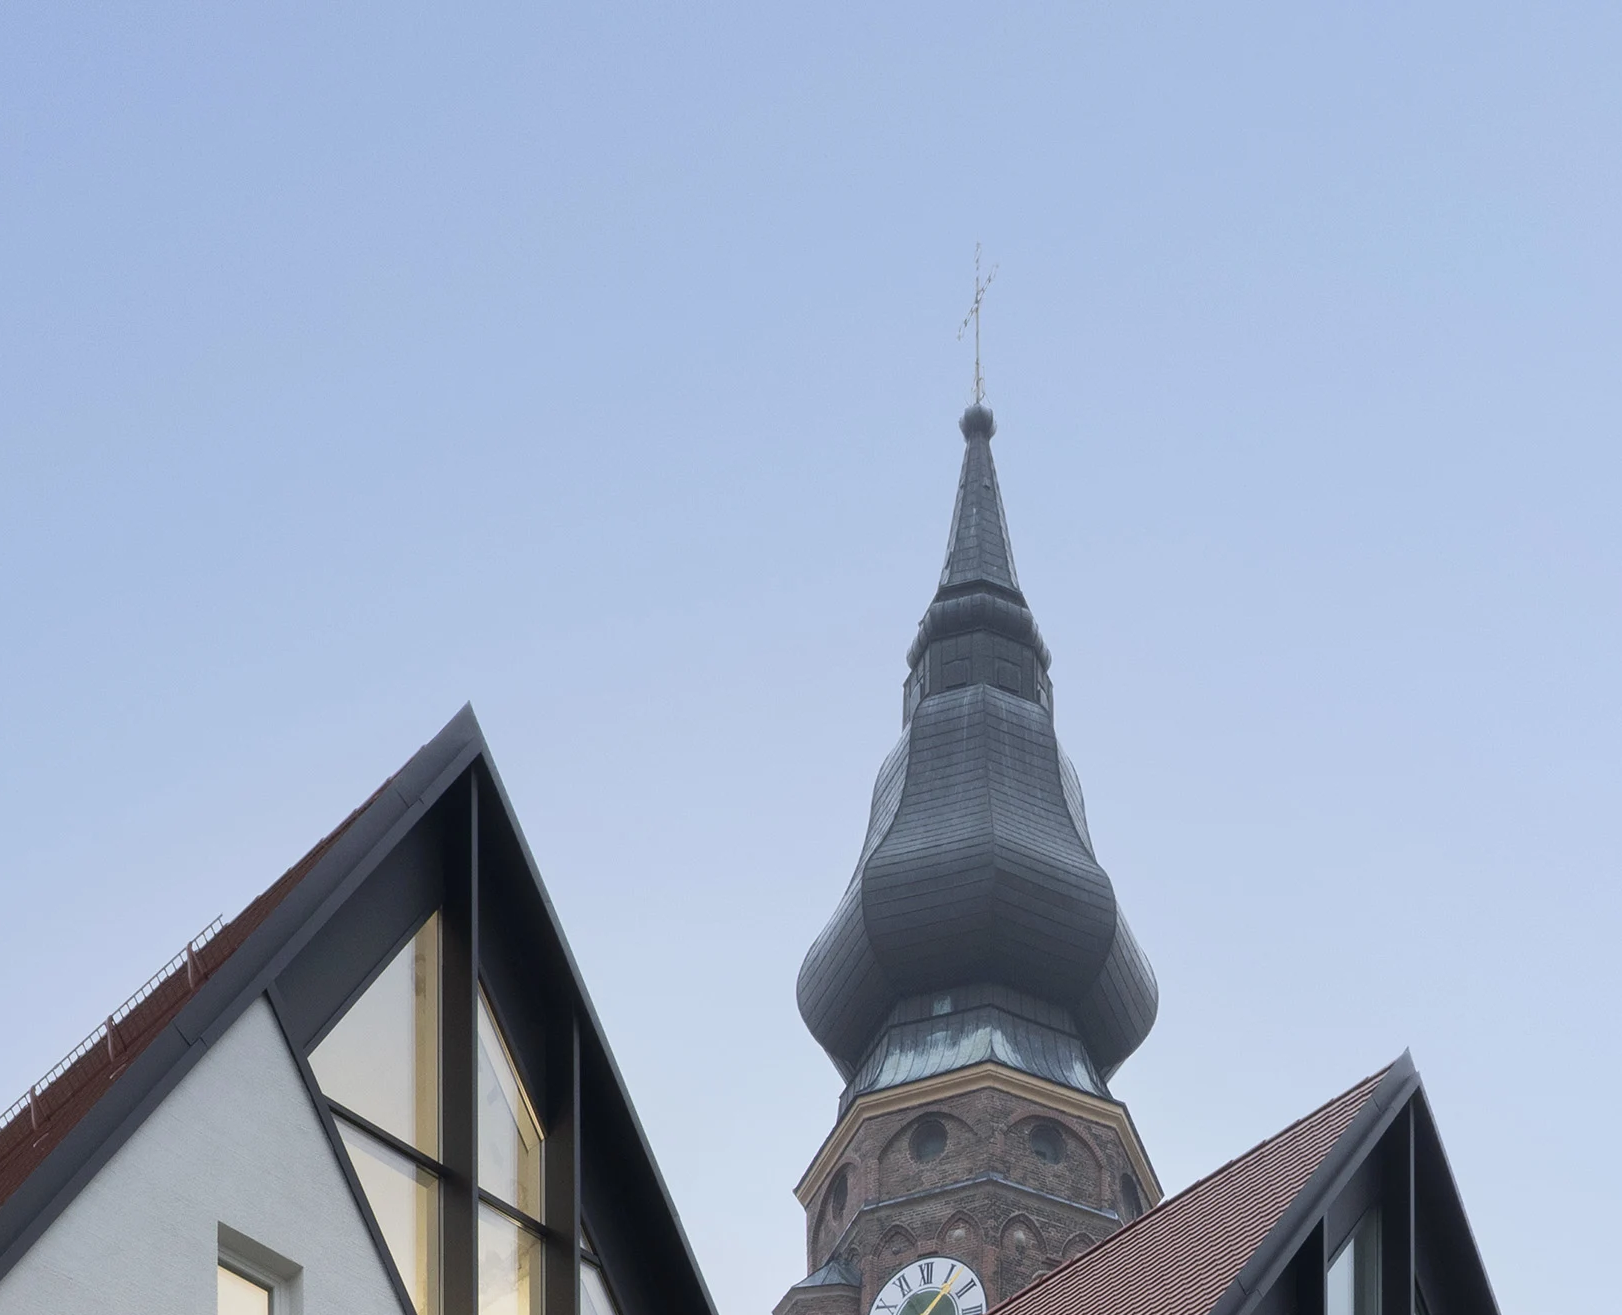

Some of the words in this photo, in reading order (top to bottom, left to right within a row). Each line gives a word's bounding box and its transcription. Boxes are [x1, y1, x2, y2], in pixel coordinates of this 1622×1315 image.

[892, 1272, 912, 1298] XI
[918, 1262, 934, 1286] XII
[955, 1278, 977, 1299] II
[876, 1298, 898, 1315] X
